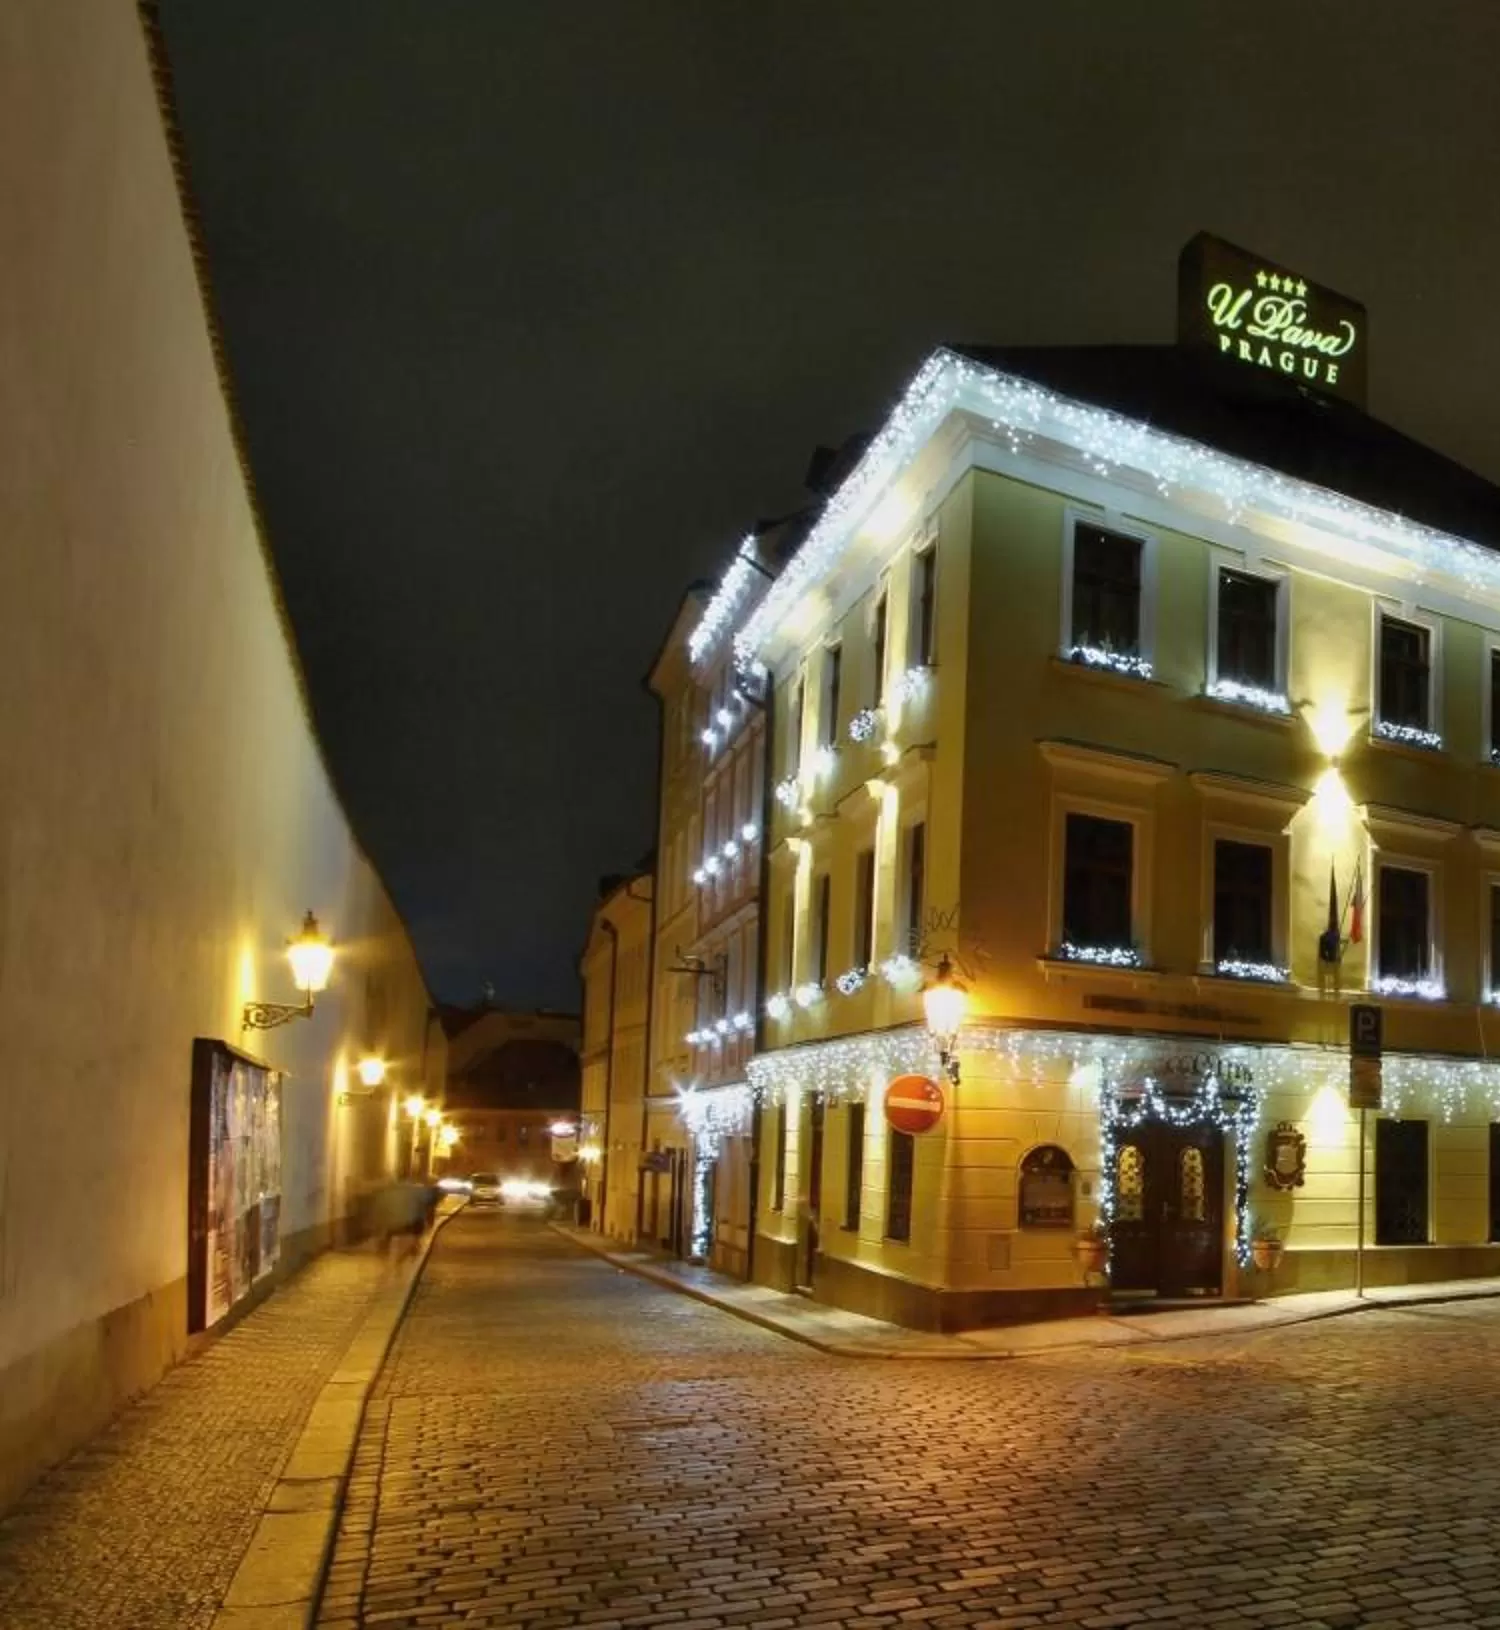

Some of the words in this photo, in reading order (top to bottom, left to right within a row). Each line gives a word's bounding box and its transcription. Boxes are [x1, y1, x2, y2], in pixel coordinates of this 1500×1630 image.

[1207, 283, 1253, 329] U
[1219, 333, 1339, 385] PRAGUE
[1357, 1010, 1376, 1041] P
